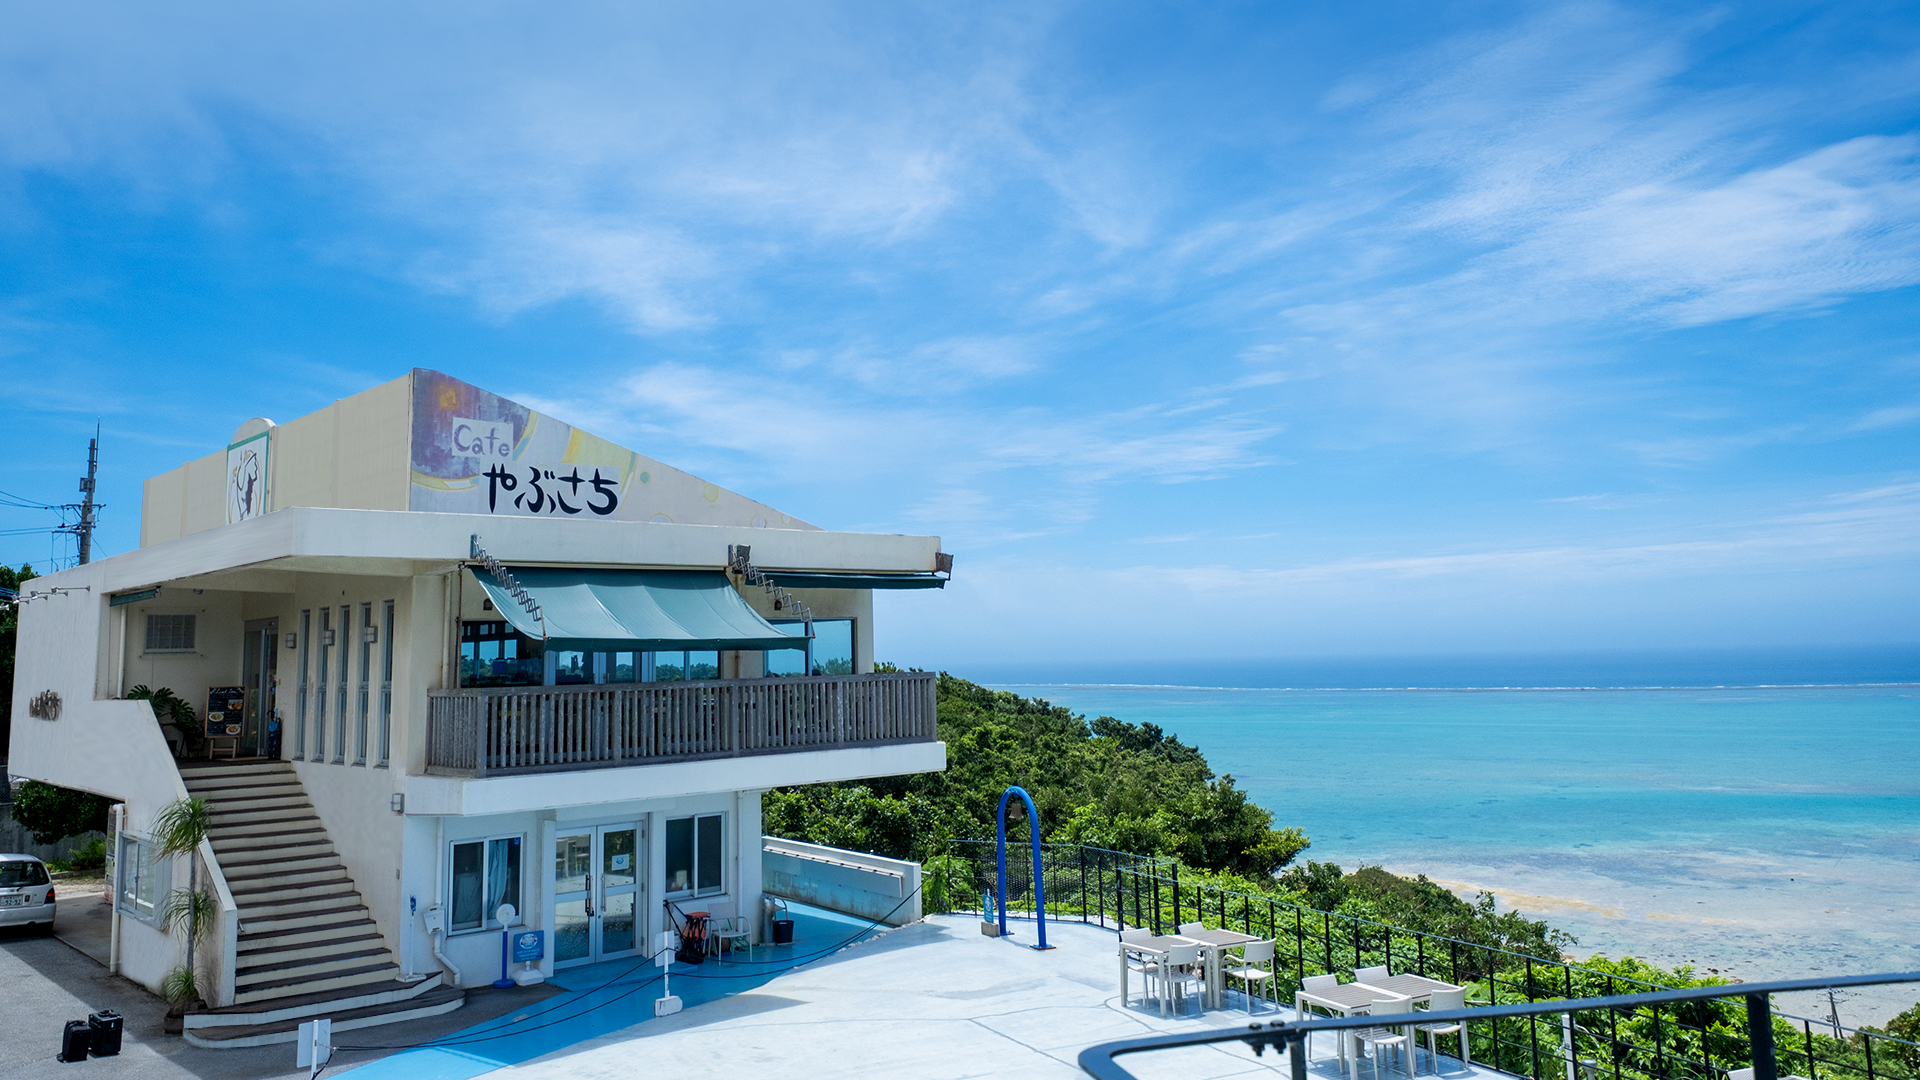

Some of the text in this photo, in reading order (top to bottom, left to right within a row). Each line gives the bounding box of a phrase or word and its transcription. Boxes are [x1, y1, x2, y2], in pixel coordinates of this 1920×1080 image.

[453, 424, 511, 457] Cafe
[482, 463, 619, 515] やぶさち
